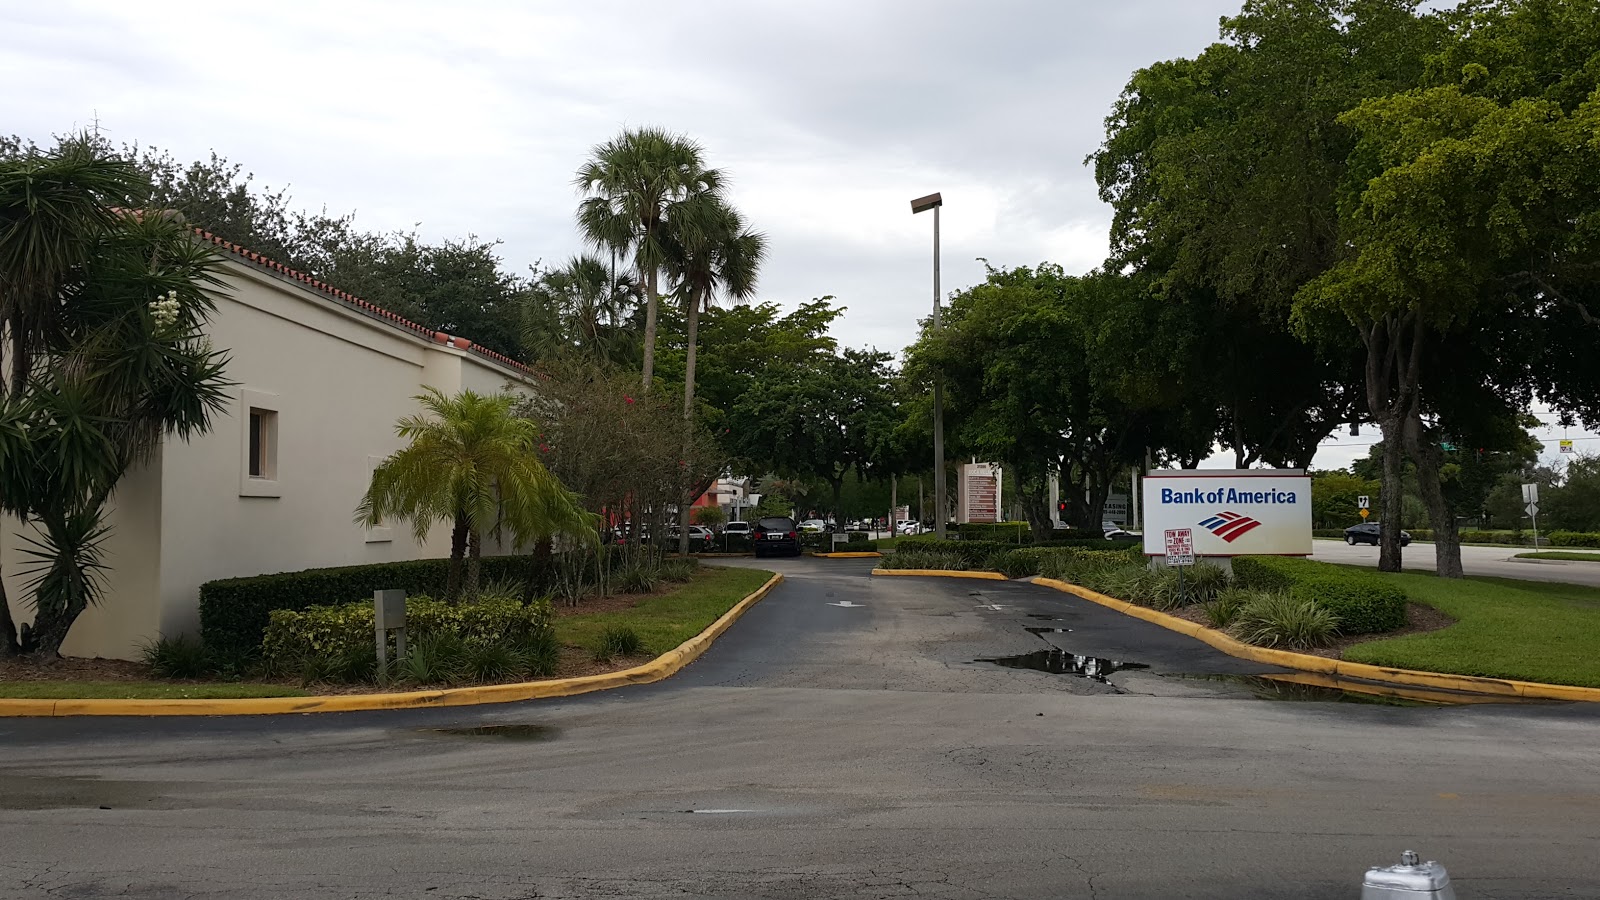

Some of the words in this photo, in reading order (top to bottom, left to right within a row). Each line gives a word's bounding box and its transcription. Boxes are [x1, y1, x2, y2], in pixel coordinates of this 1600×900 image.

[1161, 488, 1205, 504] Bank
[1206, 488, 1224, 504] of
[1226, 488, 1296, 504] America
